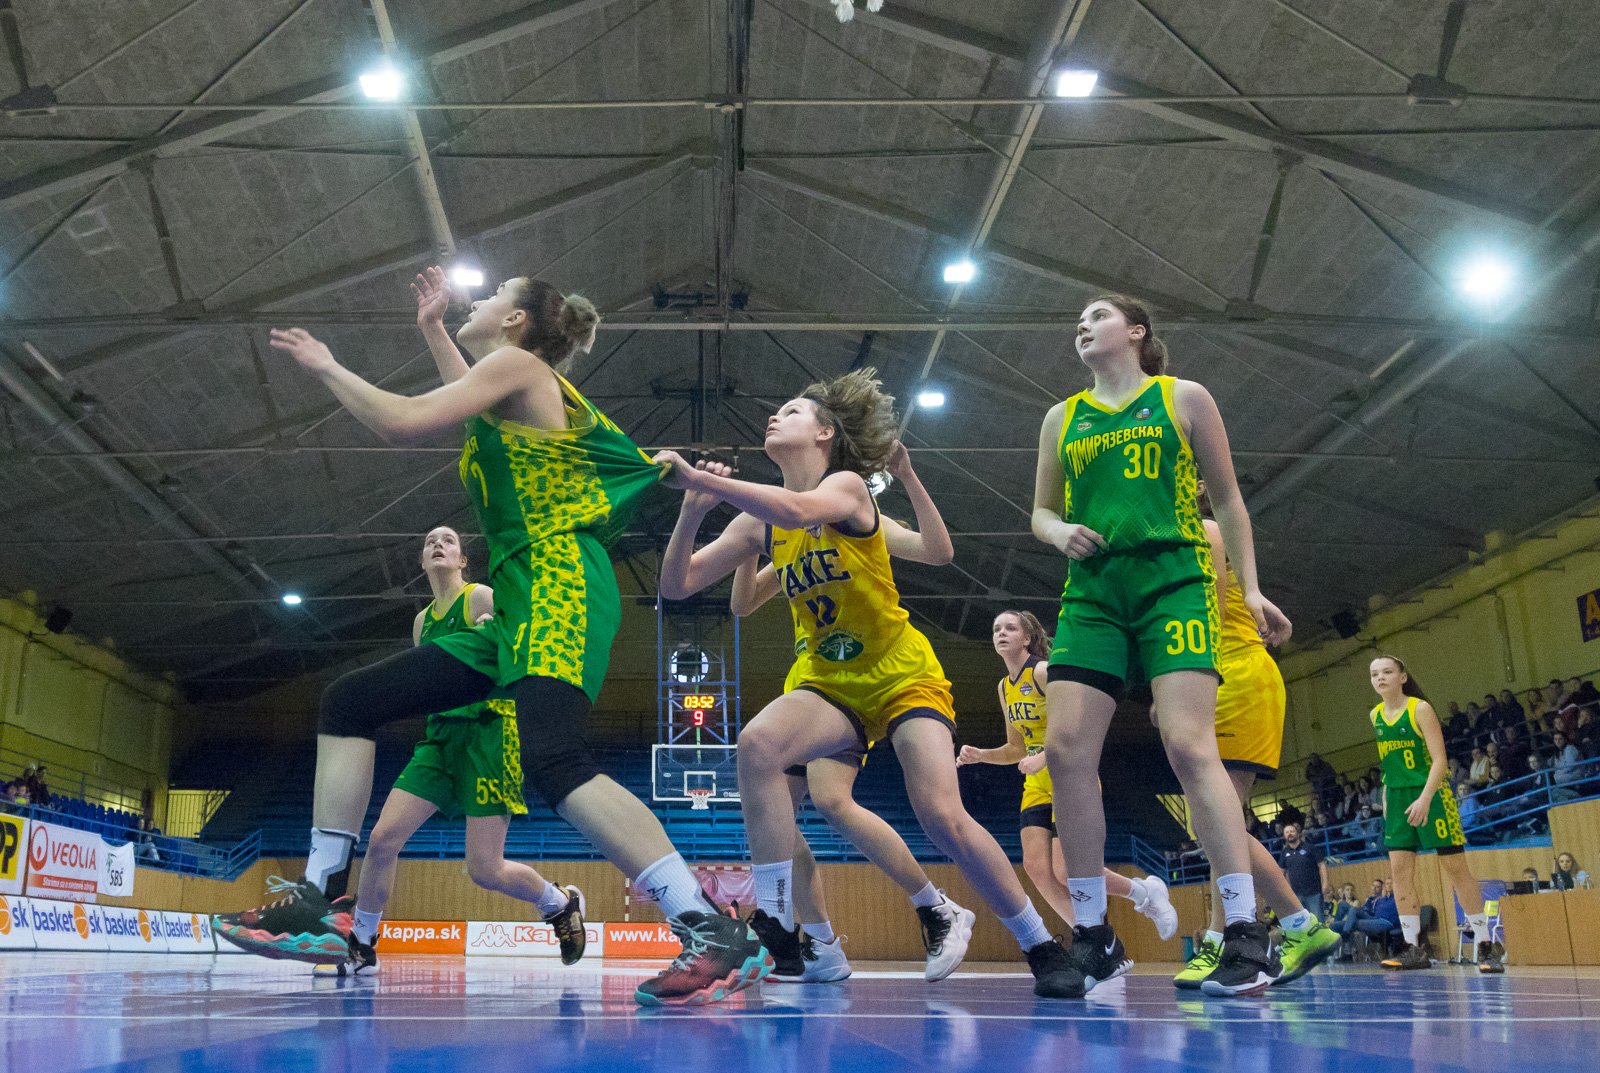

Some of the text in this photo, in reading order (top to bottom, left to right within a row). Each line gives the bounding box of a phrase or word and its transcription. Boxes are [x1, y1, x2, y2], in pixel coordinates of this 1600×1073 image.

[1065, 426, 1163, 480] ТИМИРЯЗЕВСКАЯ
[1123, 442, 1161, 479] 30
[806, 594, 837, 628] 12
[1165, 619, 1206, 655] 30
[693, 710, 704, 726] 9
[1008, 702, 1040, 723] AKE
[1403, 749, 1416, 770] 8
[476, 777, 503, 804] 55
[1435, 819, 1448, 839] 8
[52, 841, 97, 870] VEOLIA
[12, 902, 30, 928] sk
[32, 903, 102, 934] basket sk
[103, 910, 163, 937] basket sk
[165, 916, 211, 938] basket sk
[382, 924, 461, 943] kappa.sk
[515, 925, 599, 945] Kapa
[610, 927, 683, 946] www.ka
